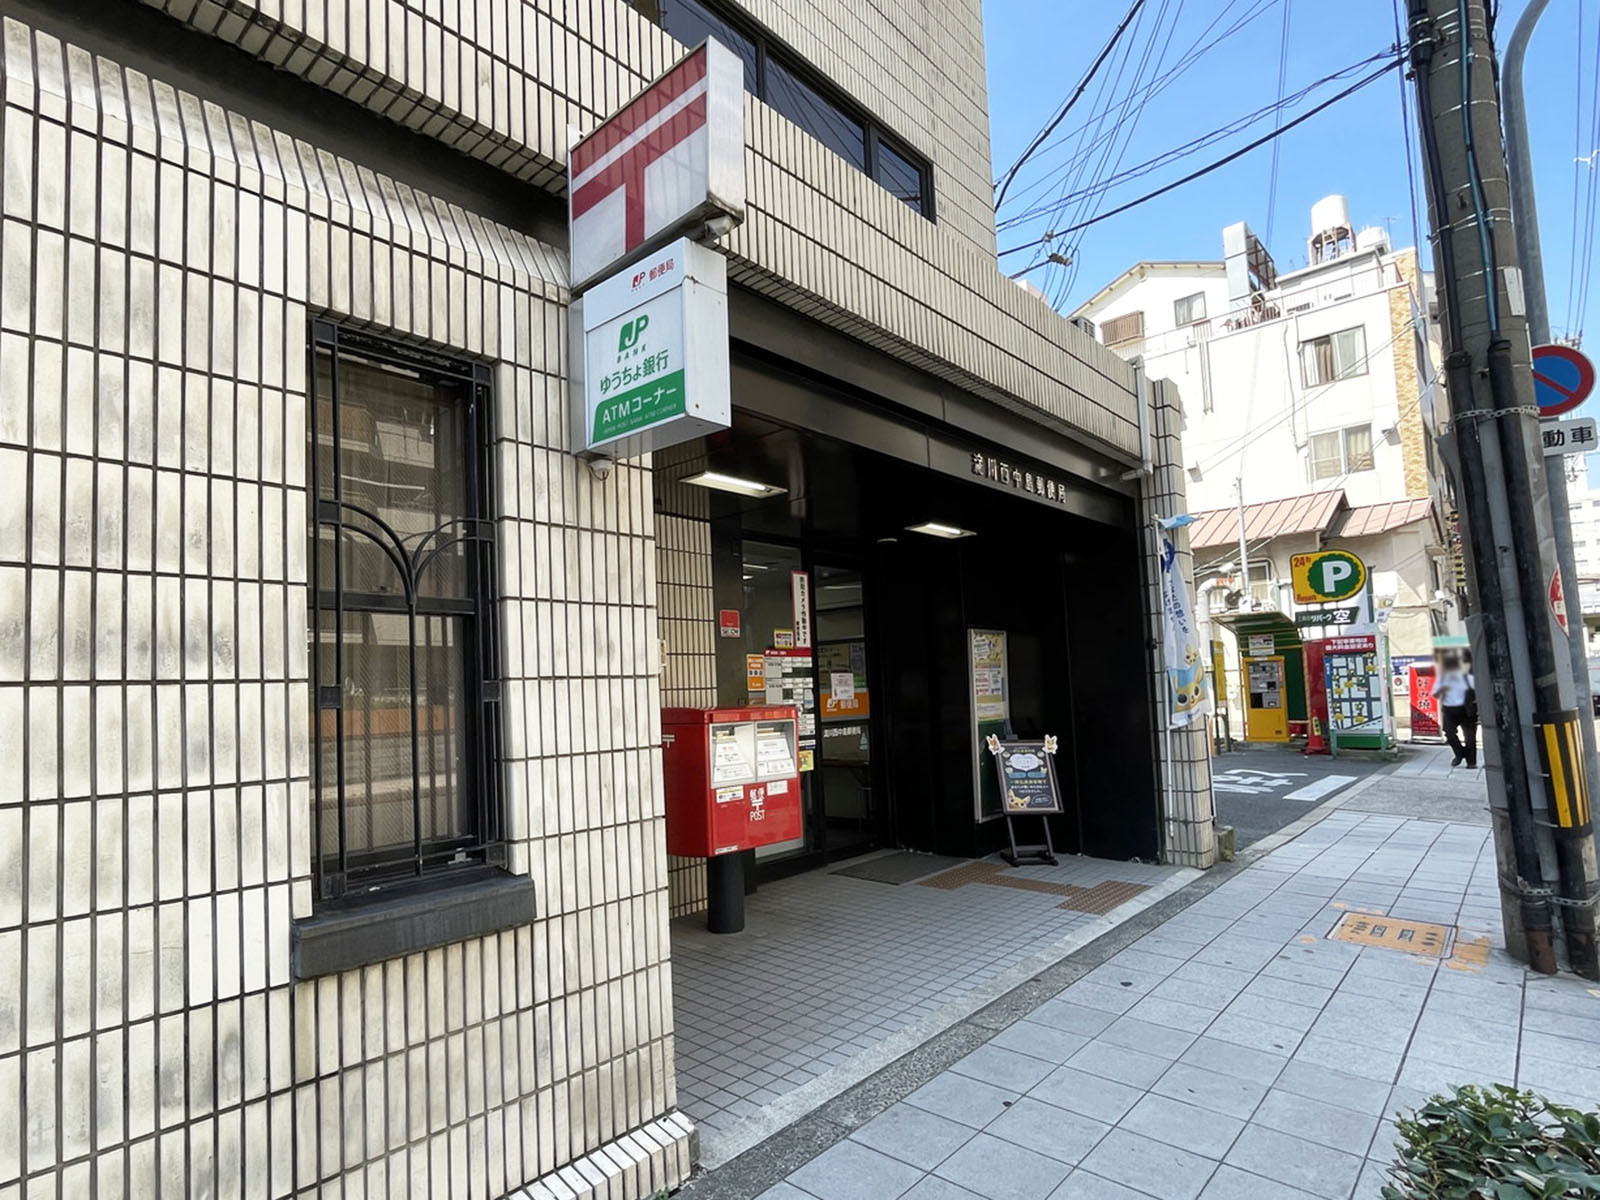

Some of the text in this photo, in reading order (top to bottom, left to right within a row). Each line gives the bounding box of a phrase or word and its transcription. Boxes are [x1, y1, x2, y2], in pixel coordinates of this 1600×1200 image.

[649, 258, 675, 281] 郵便局
[617, 344, 647, 363] BANK
[600, 349, 669, 394] ゆうちょ銀行
[602, 387, 677, 425] ATMコーナー
[1322, 560, 1352, 593] P
[1333, 609, 1351, 624] 空
[750, 809, 765, 822] POST
